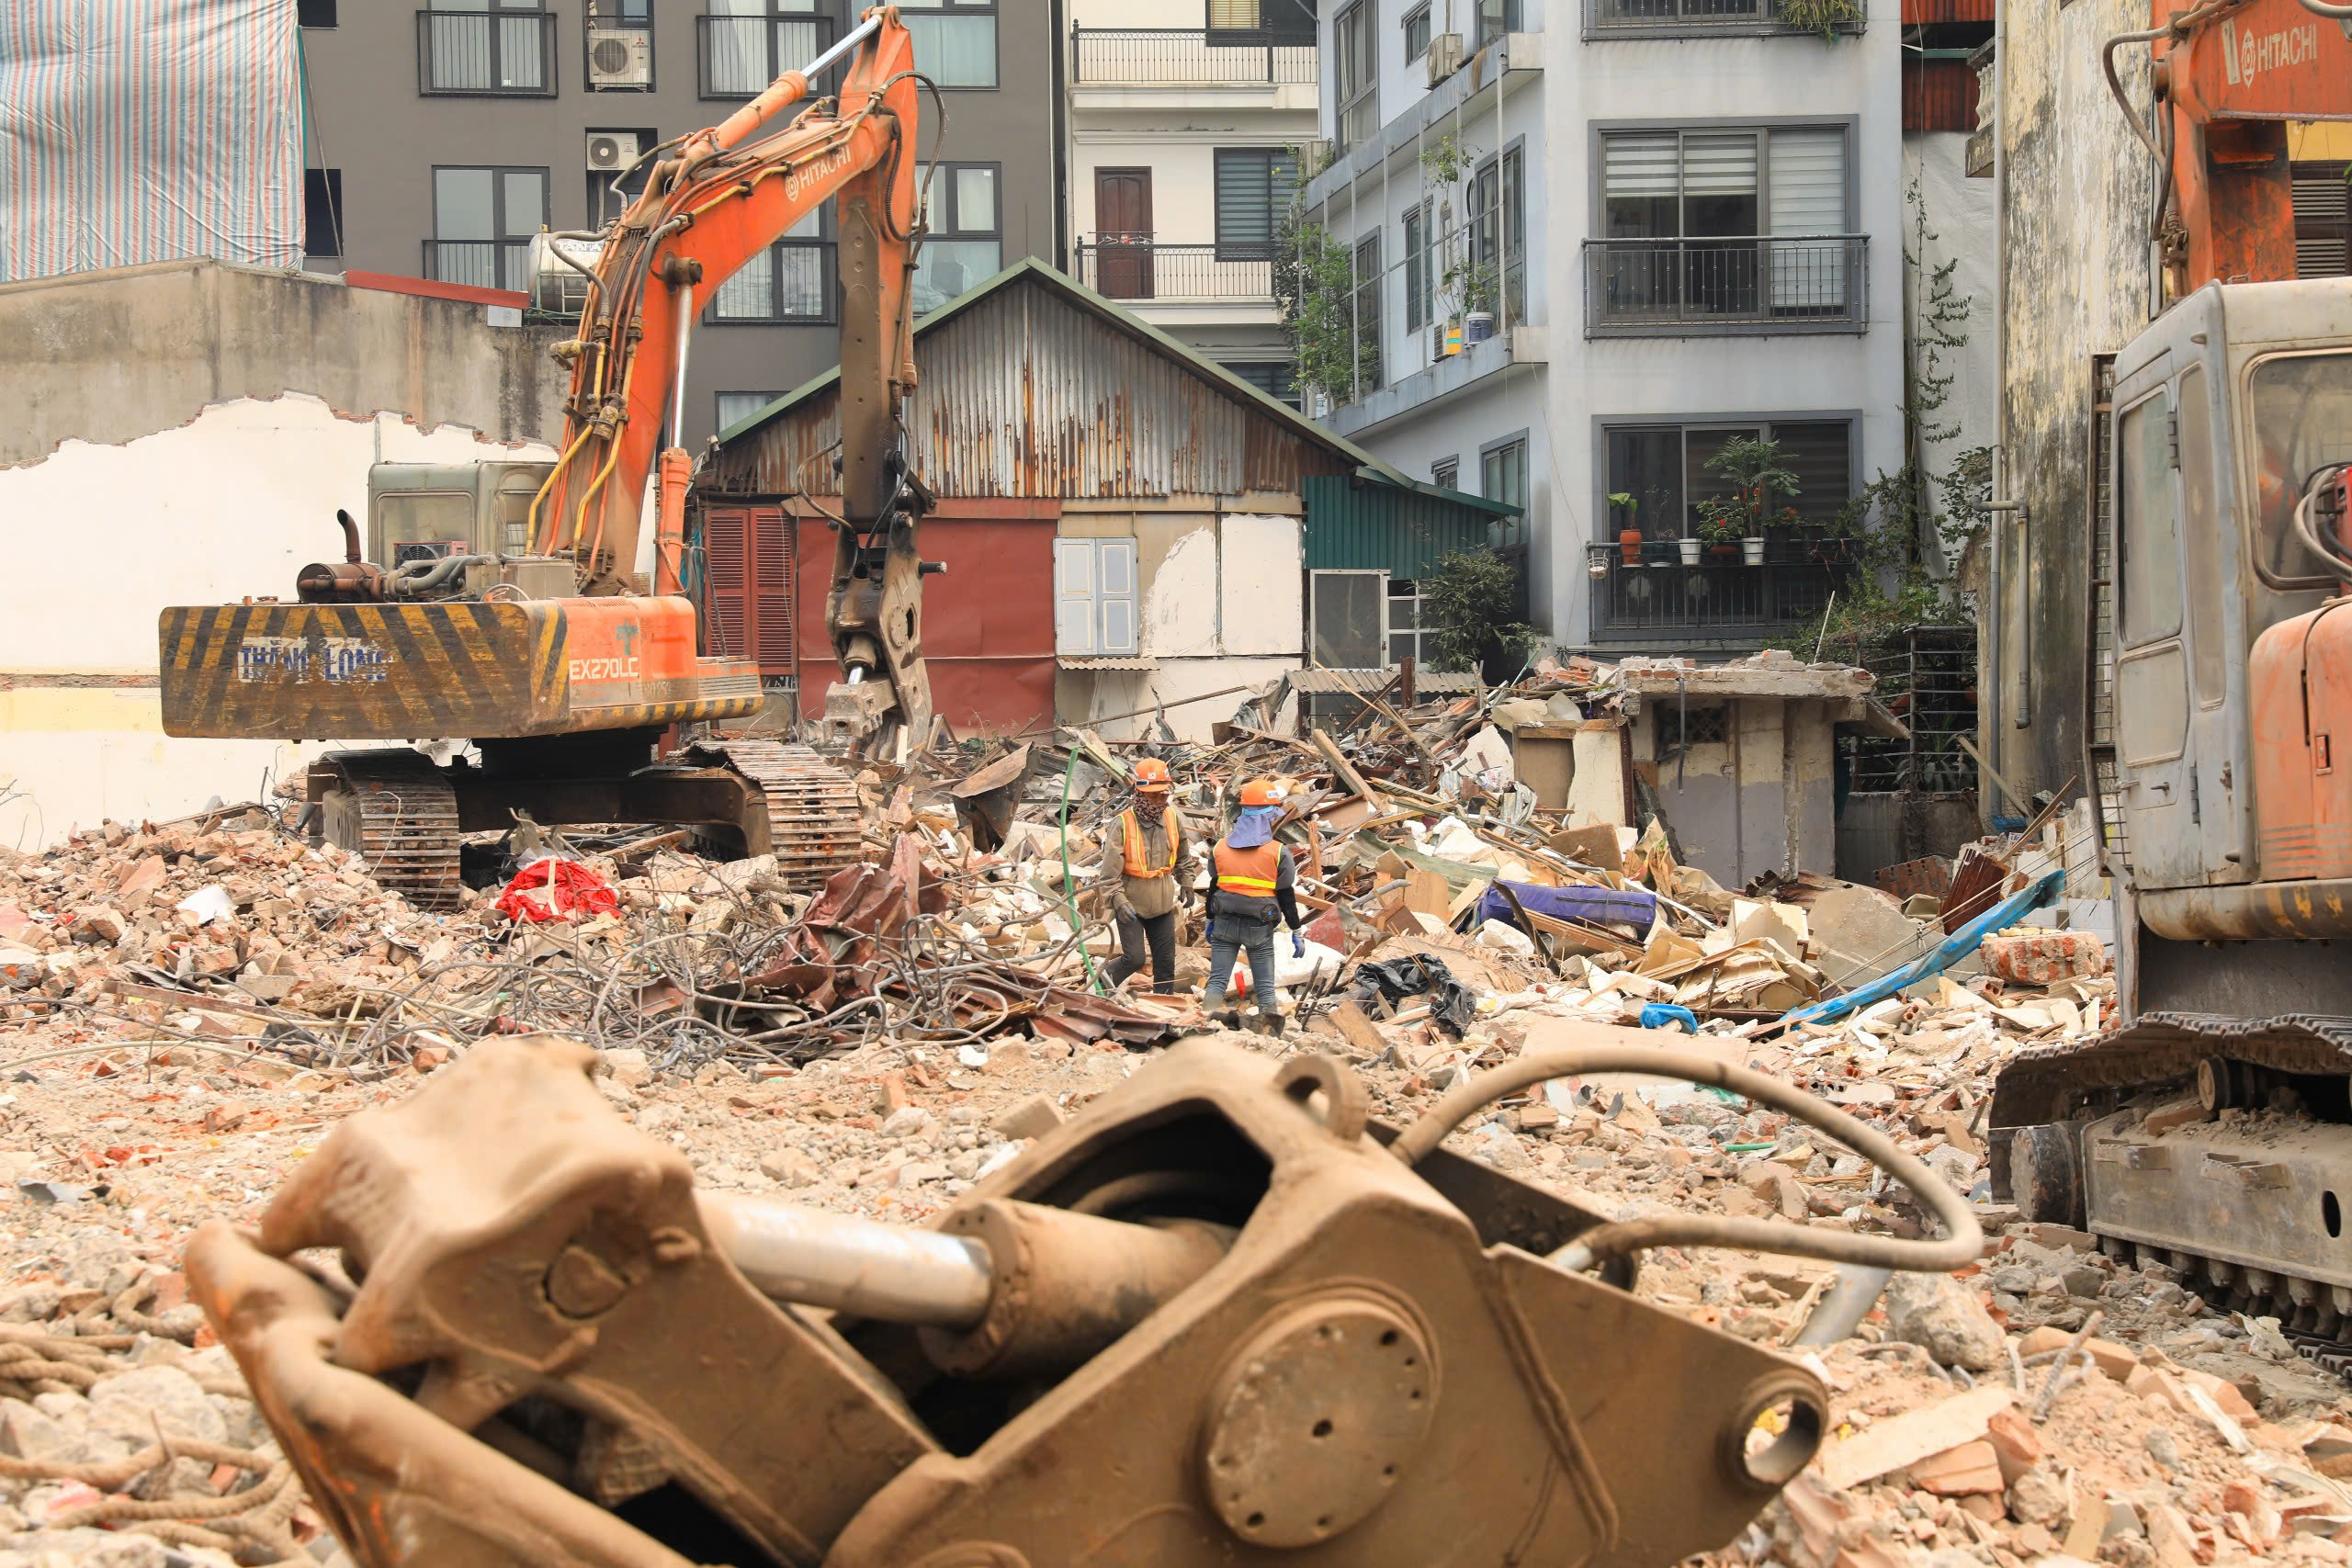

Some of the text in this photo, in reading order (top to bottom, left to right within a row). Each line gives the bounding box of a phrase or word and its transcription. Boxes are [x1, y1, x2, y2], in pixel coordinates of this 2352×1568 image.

[2256, 23, 2317, 73] HITACHI
[799, 145, 852, 190] HITACHI
[569, 657, 639, 681] EX270LC
